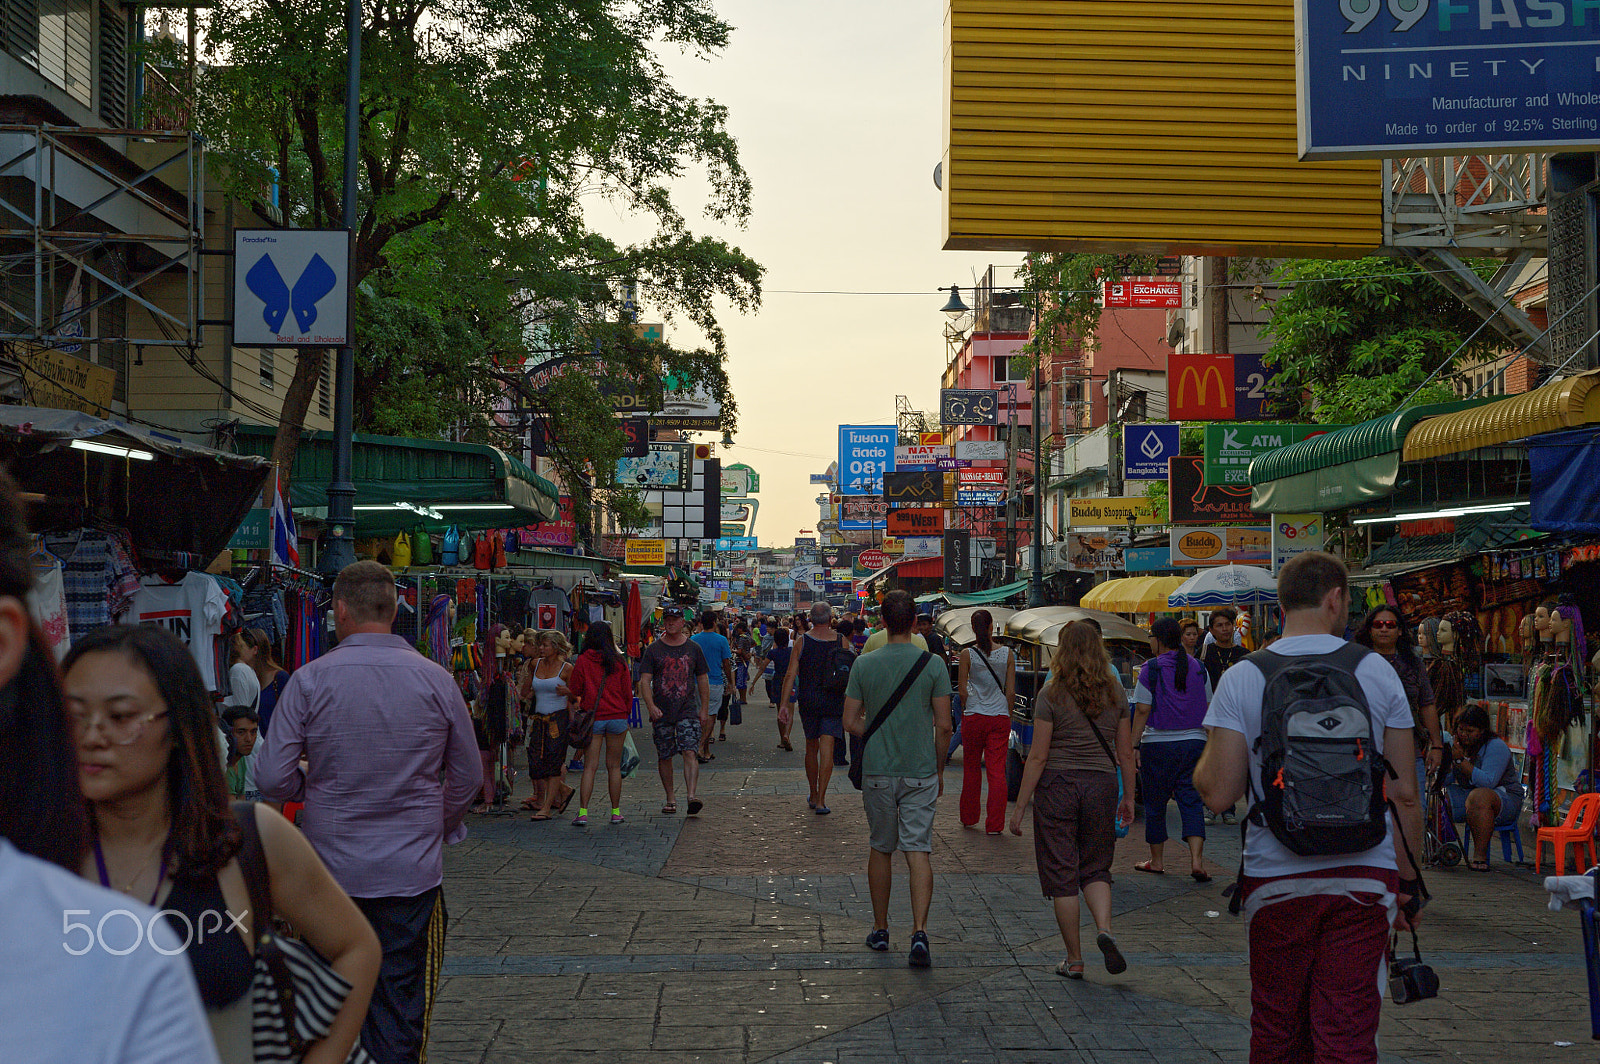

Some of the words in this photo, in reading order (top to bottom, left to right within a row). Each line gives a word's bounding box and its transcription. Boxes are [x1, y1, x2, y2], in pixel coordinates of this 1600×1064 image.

[1342, 58, 1545, 81] NINETY
[1432, 95, 1518, 110] Manufacturer
[1525, 93, 1549, 107] and
[1385, 122, 1418, 136] Made
[1425, 122, 1438, 135] to
[1445, 120, 1476, 134] order
[1484, 119, 1497, 132] of
[1503, 118, 1545, 132] 92.5%
[1552, 116, 1598, 132] Sterling
[1133, 287, 1179, 295] EXCHANGE
[276, 335, 294, 343] Retail
[297, 335, 310, 343] and
[313, 335, 345, 343] Wholesale
[849, 431, 889, 443] โฆษณา
[1251, 435, 1283, 447] ATM
[852, 447, 887, 458] ติดต่อ
[849, 460, 887, 474] 081
[1127, 467, 1158, 475] Bangkok
[843, 502, 889, 514] TATTOO
[1071, 506, 1102, 519] Buddy
[896, 513, 910, 521] 999
[911, 514, 938, 527] WEST
[1186, 536, 1216, 548] Buddy
